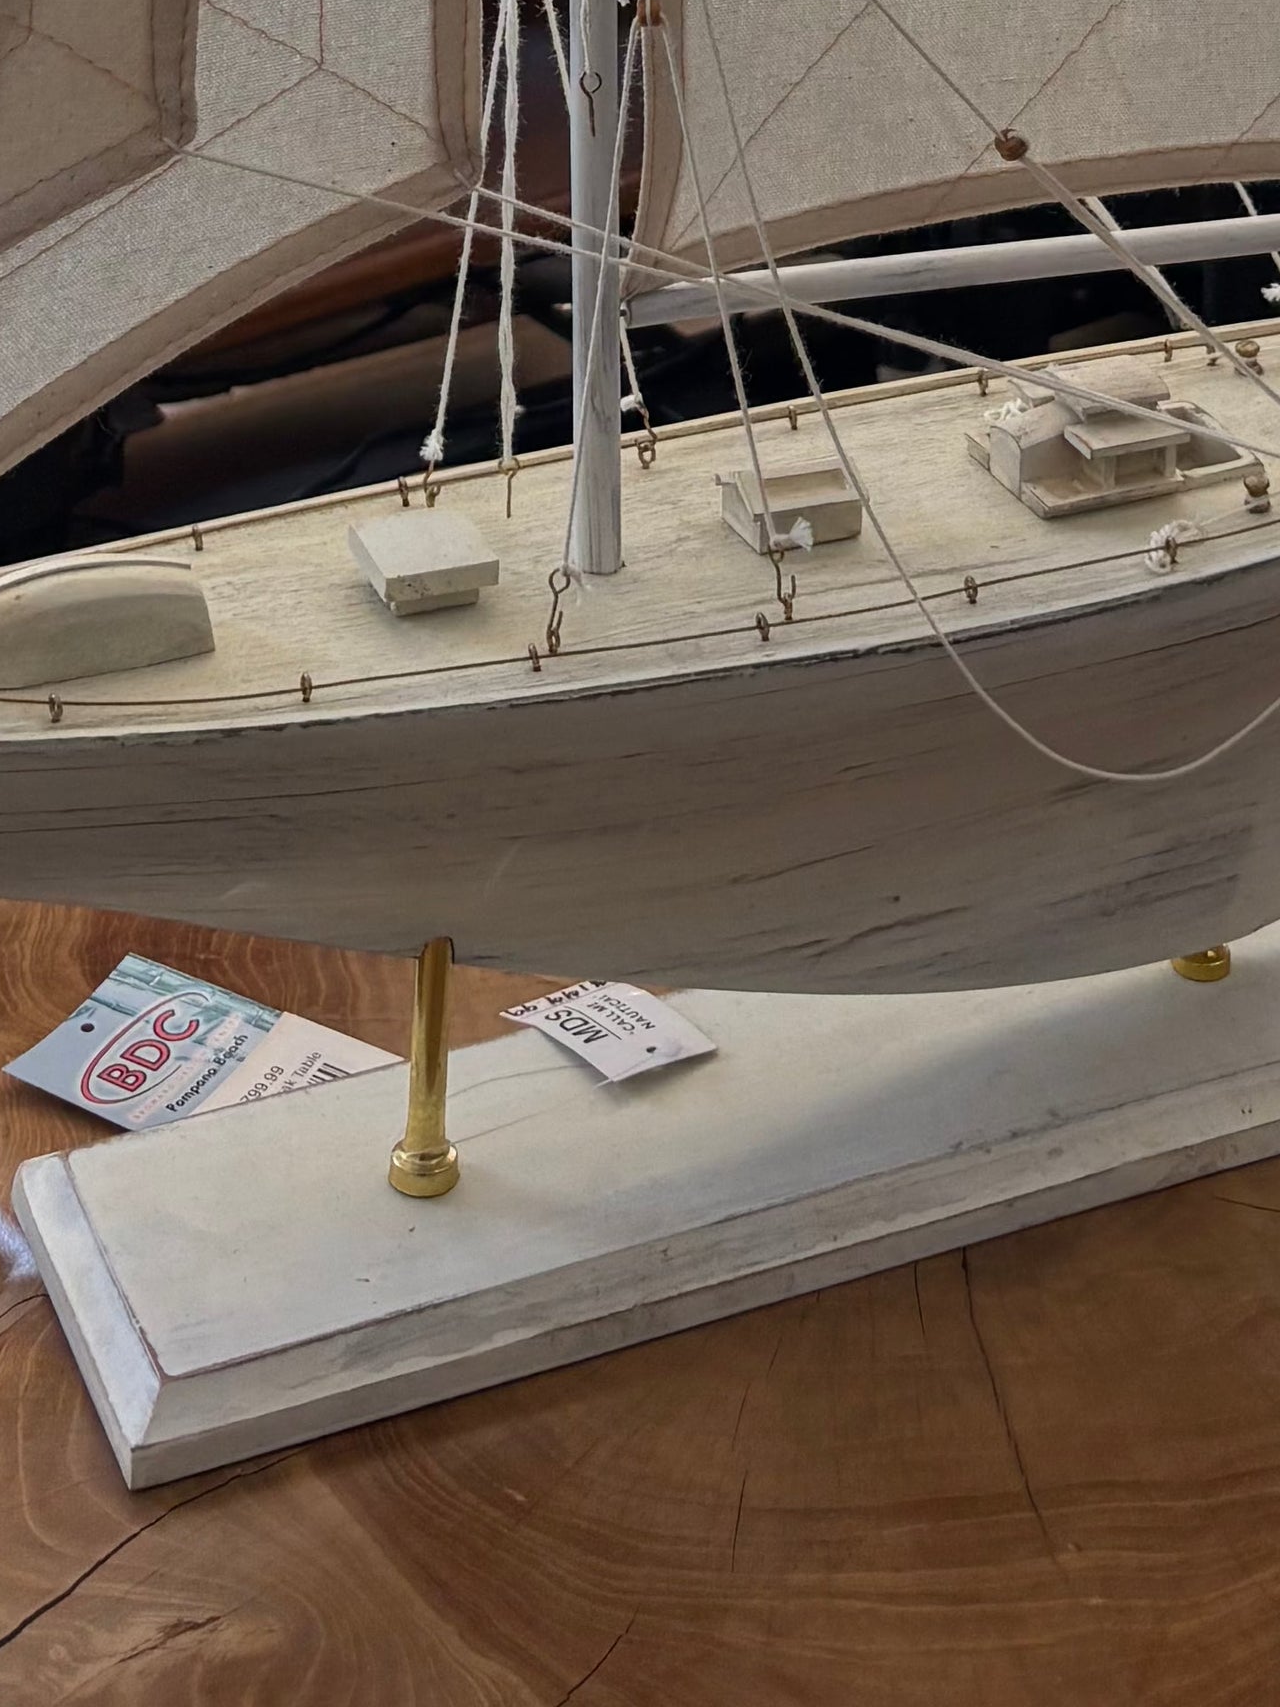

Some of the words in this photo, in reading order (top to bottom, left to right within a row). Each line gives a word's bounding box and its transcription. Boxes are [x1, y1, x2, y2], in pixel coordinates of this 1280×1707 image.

[544, 1009, 609, 1044] MDS
[96, 1009, 200, 1093] BDC
[213, 1034, 249, 1067] Beach
[293, 1050, 323, 1078] Table
